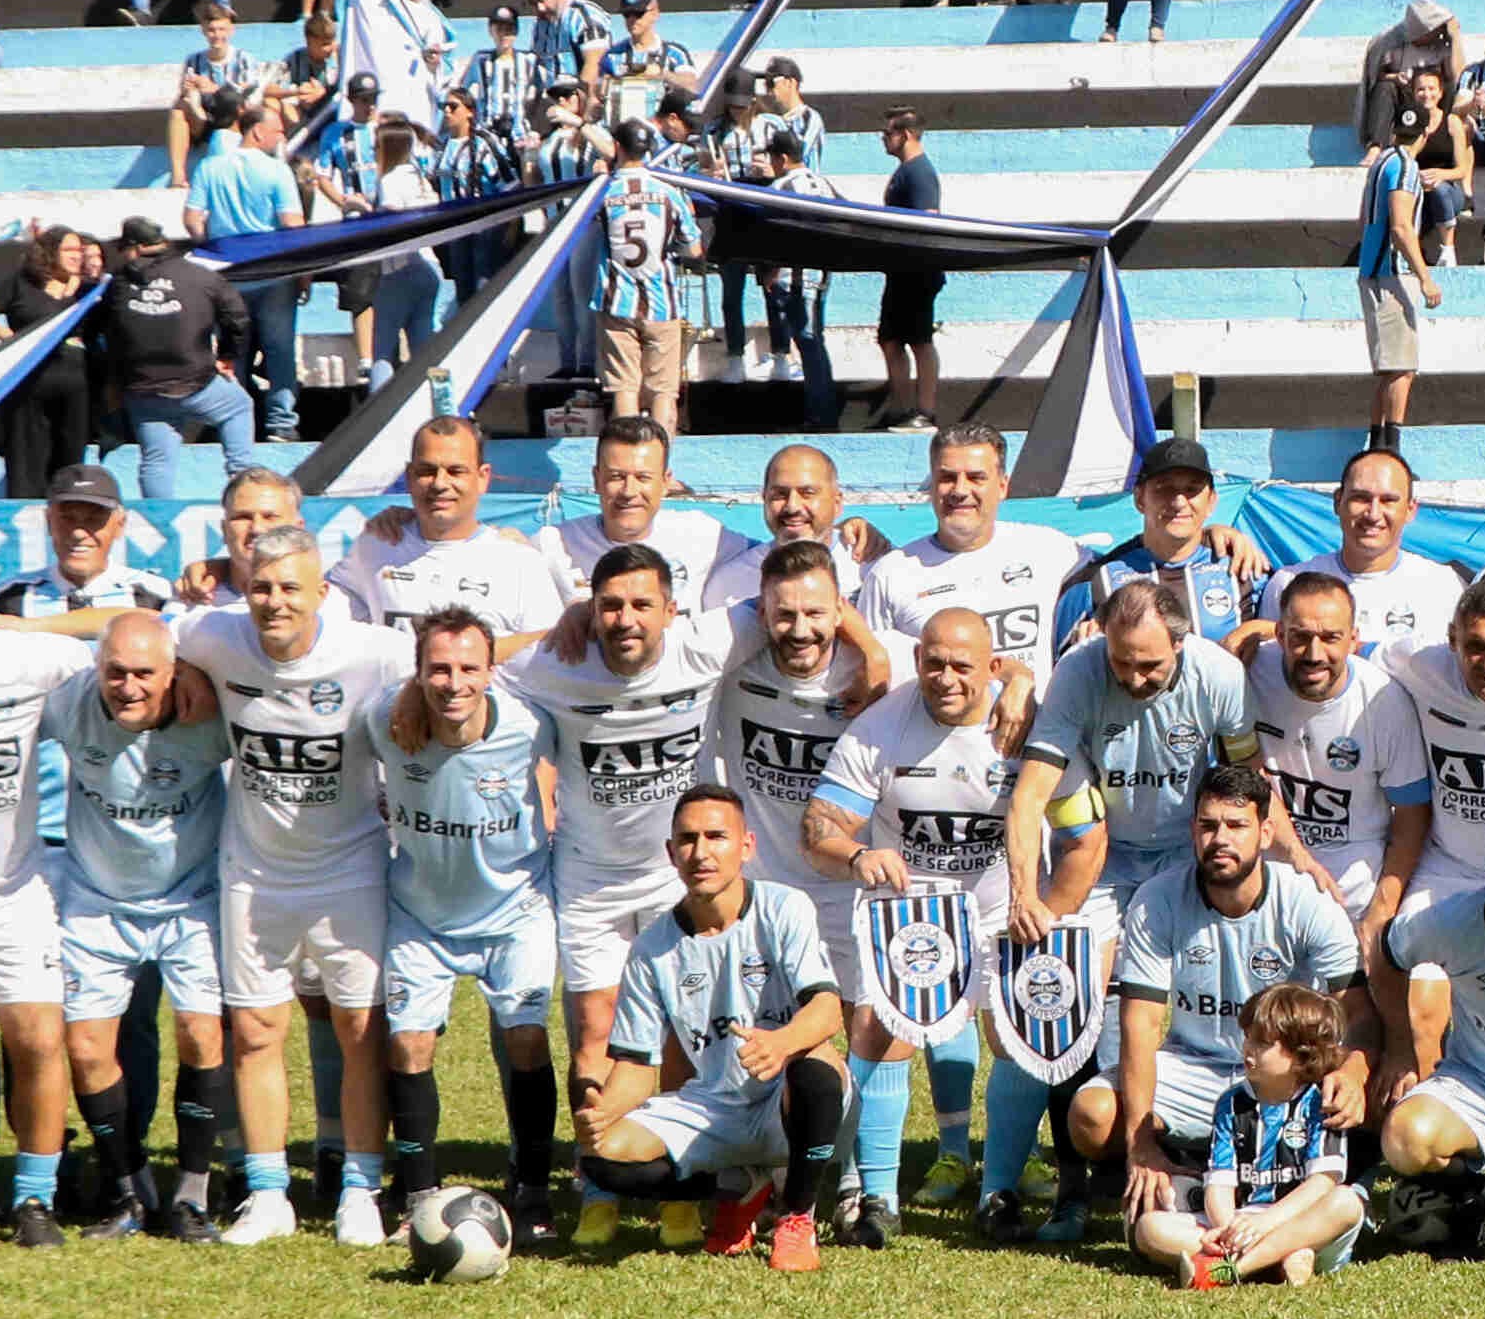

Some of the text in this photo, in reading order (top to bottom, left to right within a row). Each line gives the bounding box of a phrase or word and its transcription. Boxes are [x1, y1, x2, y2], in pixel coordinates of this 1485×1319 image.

[625, 221, 648, 268] 5
[238, 735, 341, 772] AIS
[594, 730, 701, 773] AIS
[745, 730, 835, 773] AIS
[416, 810, 520, 839] Banrisul
[904, 815, 1005, 845] AIS
